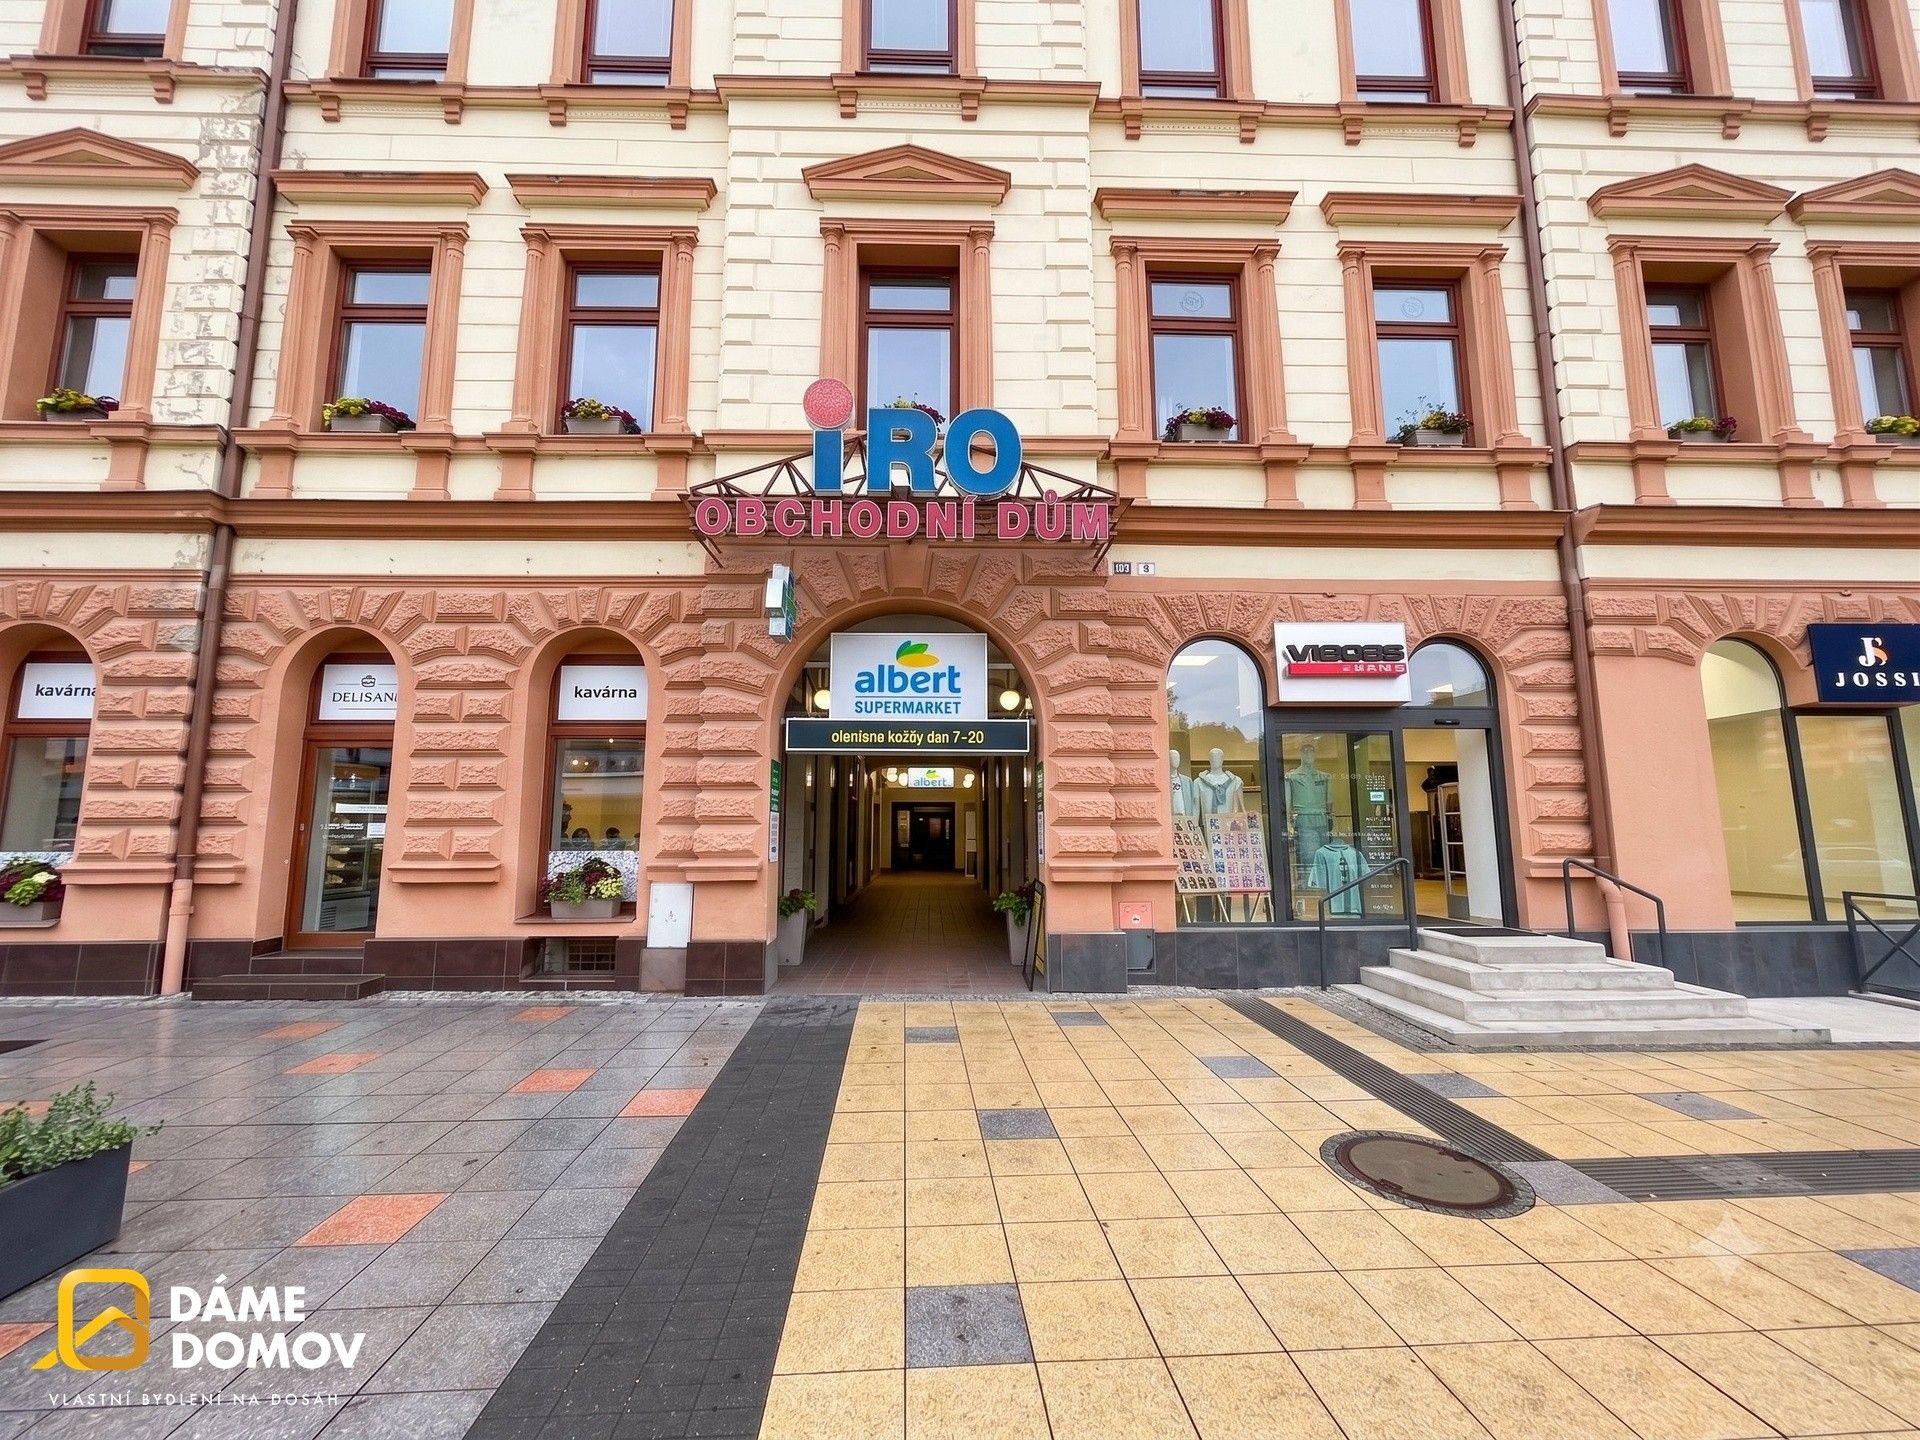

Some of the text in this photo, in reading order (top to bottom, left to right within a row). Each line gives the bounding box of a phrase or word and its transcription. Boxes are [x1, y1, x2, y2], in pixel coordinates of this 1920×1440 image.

[695, 488, 1111, 541] OBCHODNÍ DŮM
[854, 665, 962, 694] albert
[332, 692, 397, 702] DELISAN
[574, 686, 637, 698] kavárna
[854, 701, 962, 715] SUPERMARKET
[927, 730, 950, 744] dan
[952, 730, 985, 744] 7-20
[913, 778, 947, 787] albert
